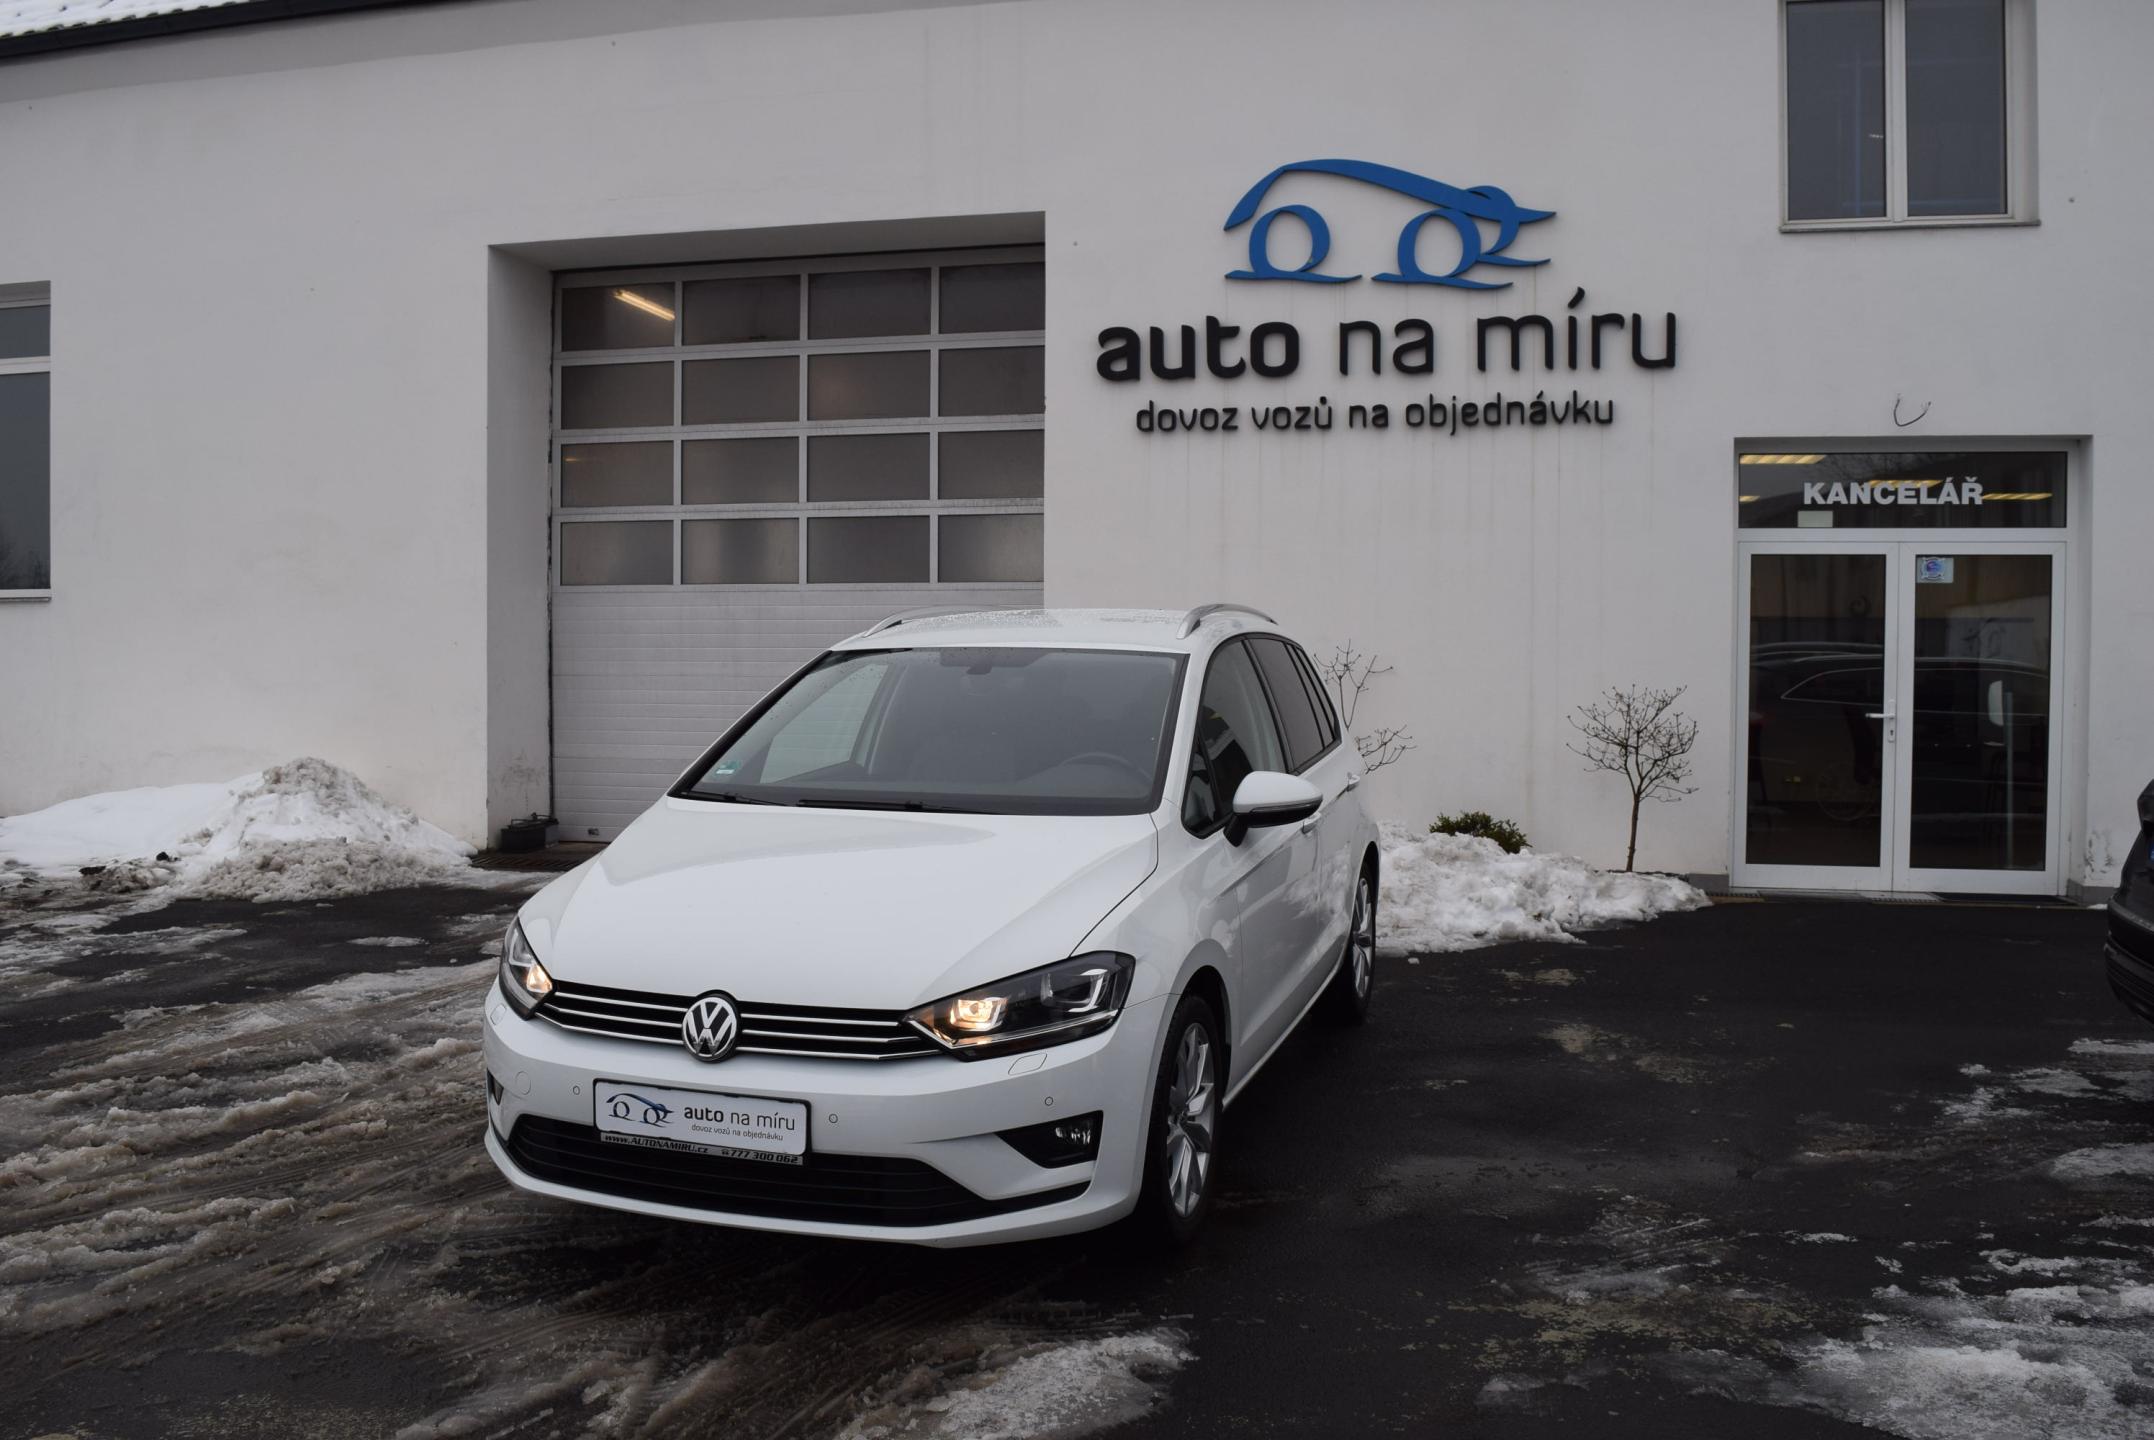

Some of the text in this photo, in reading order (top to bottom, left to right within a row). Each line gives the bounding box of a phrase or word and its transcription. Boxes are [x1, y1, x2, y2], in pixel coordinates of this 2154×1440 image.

[1096, 286, 1676, 381] auto na míru
[1136, 390, 1614, 436] dovoz vozů na objednávku
[1803, 476, 1984, 505] KANCELÁŘ
[684, 1106, 795, 1130] auto na míru
[691, 1123, 712, 1133] dovoz
[713, 1127, 730, 1135] vozů
[743, 1130, 783, 1141] objednávku
